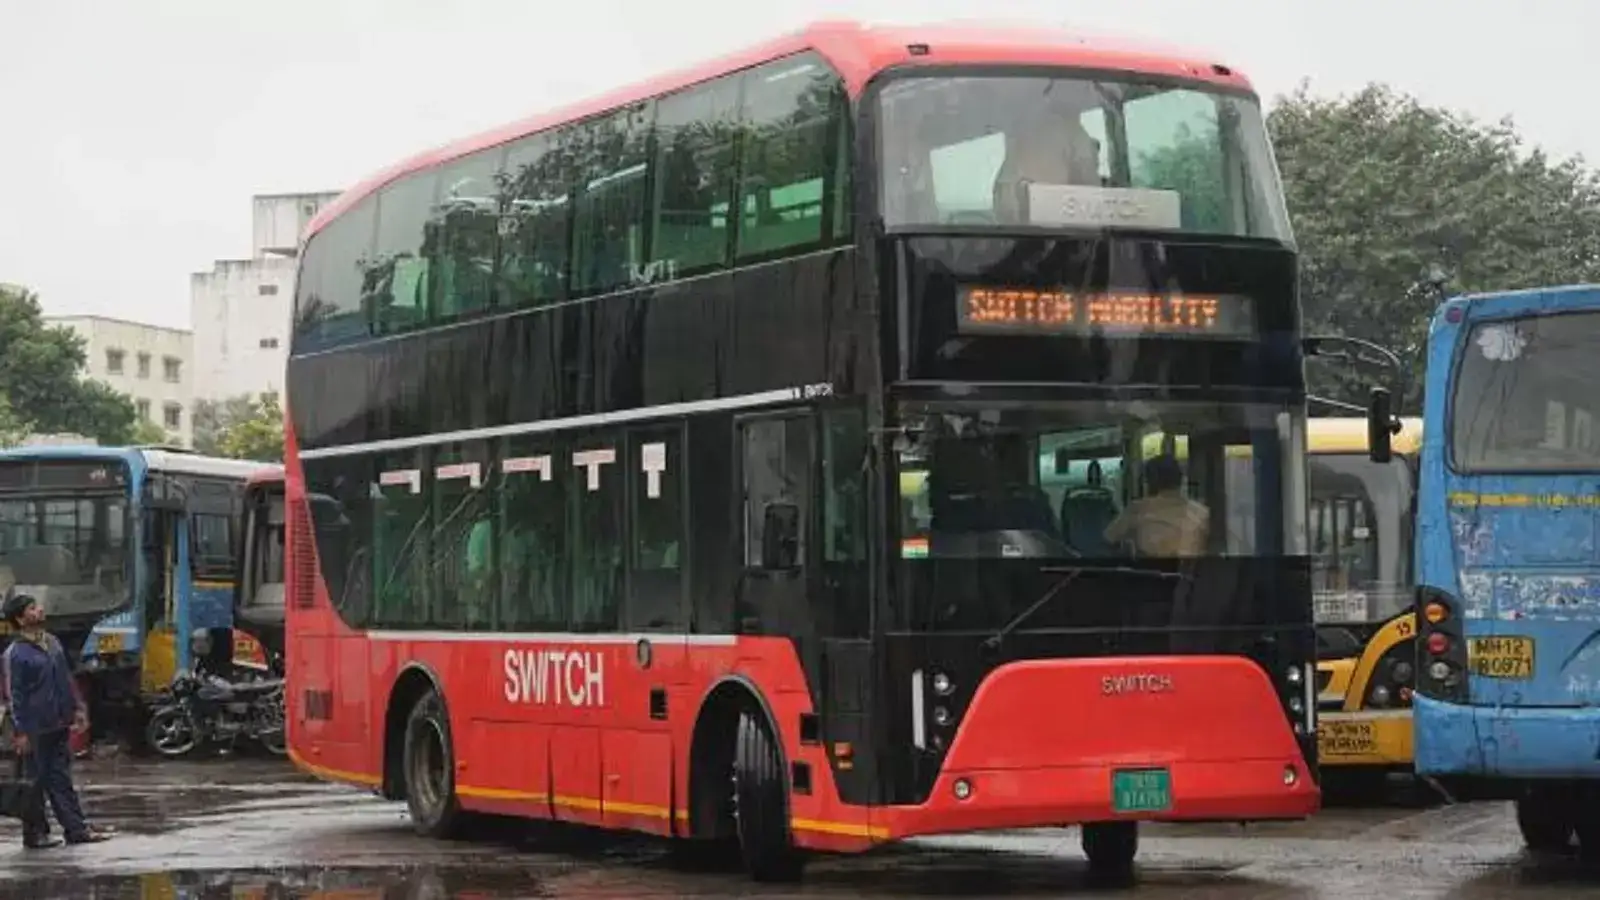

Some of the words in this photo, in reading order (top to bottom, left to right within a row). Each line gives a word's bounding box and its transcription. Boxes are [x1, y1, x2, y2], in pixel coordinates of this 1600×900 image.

[968, 289, 1073, 323] SWITCH
[504, 649, 604, 706] SWITCH
[1102, 674, 1174, 694] SWITCH
